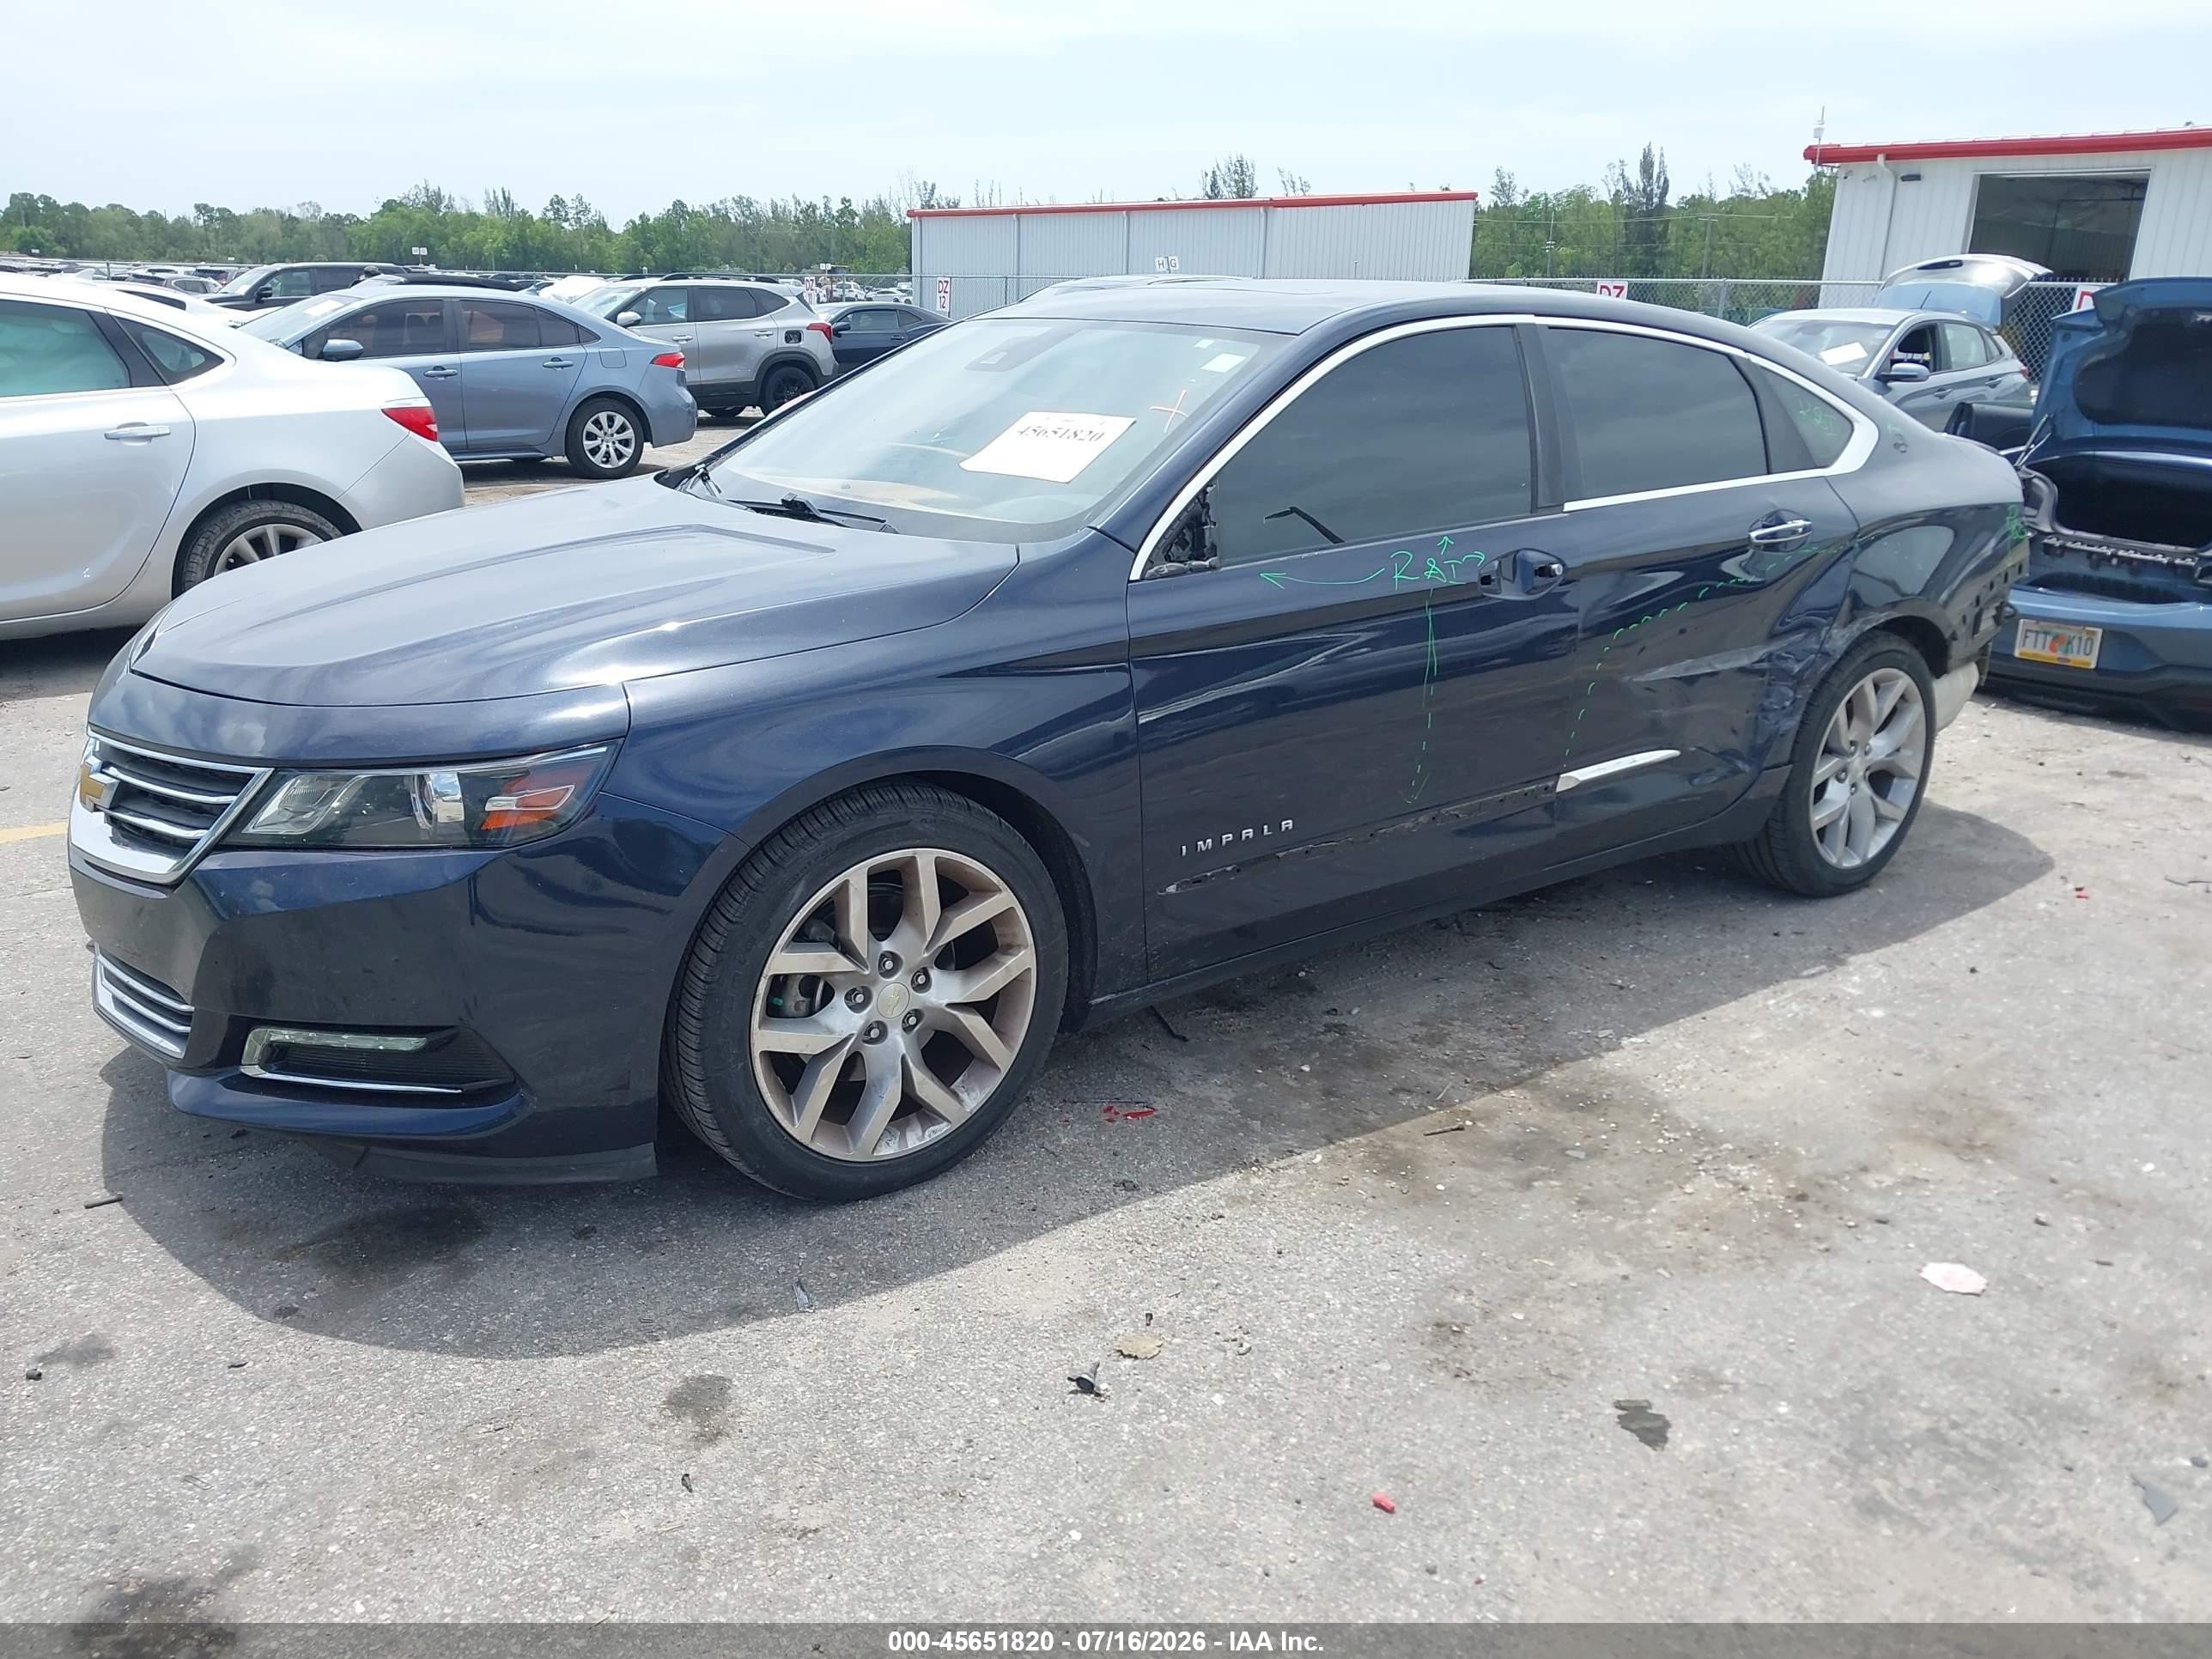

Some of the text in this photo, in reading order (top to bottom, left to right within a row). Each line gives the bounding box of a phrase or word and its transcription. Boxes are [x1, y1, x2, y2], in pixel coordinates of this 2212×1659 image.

[938, 280, 949, 294] DZ
[939, 295, 946, 309] 12
[1180, 819, 1293, 857] IMPALA
